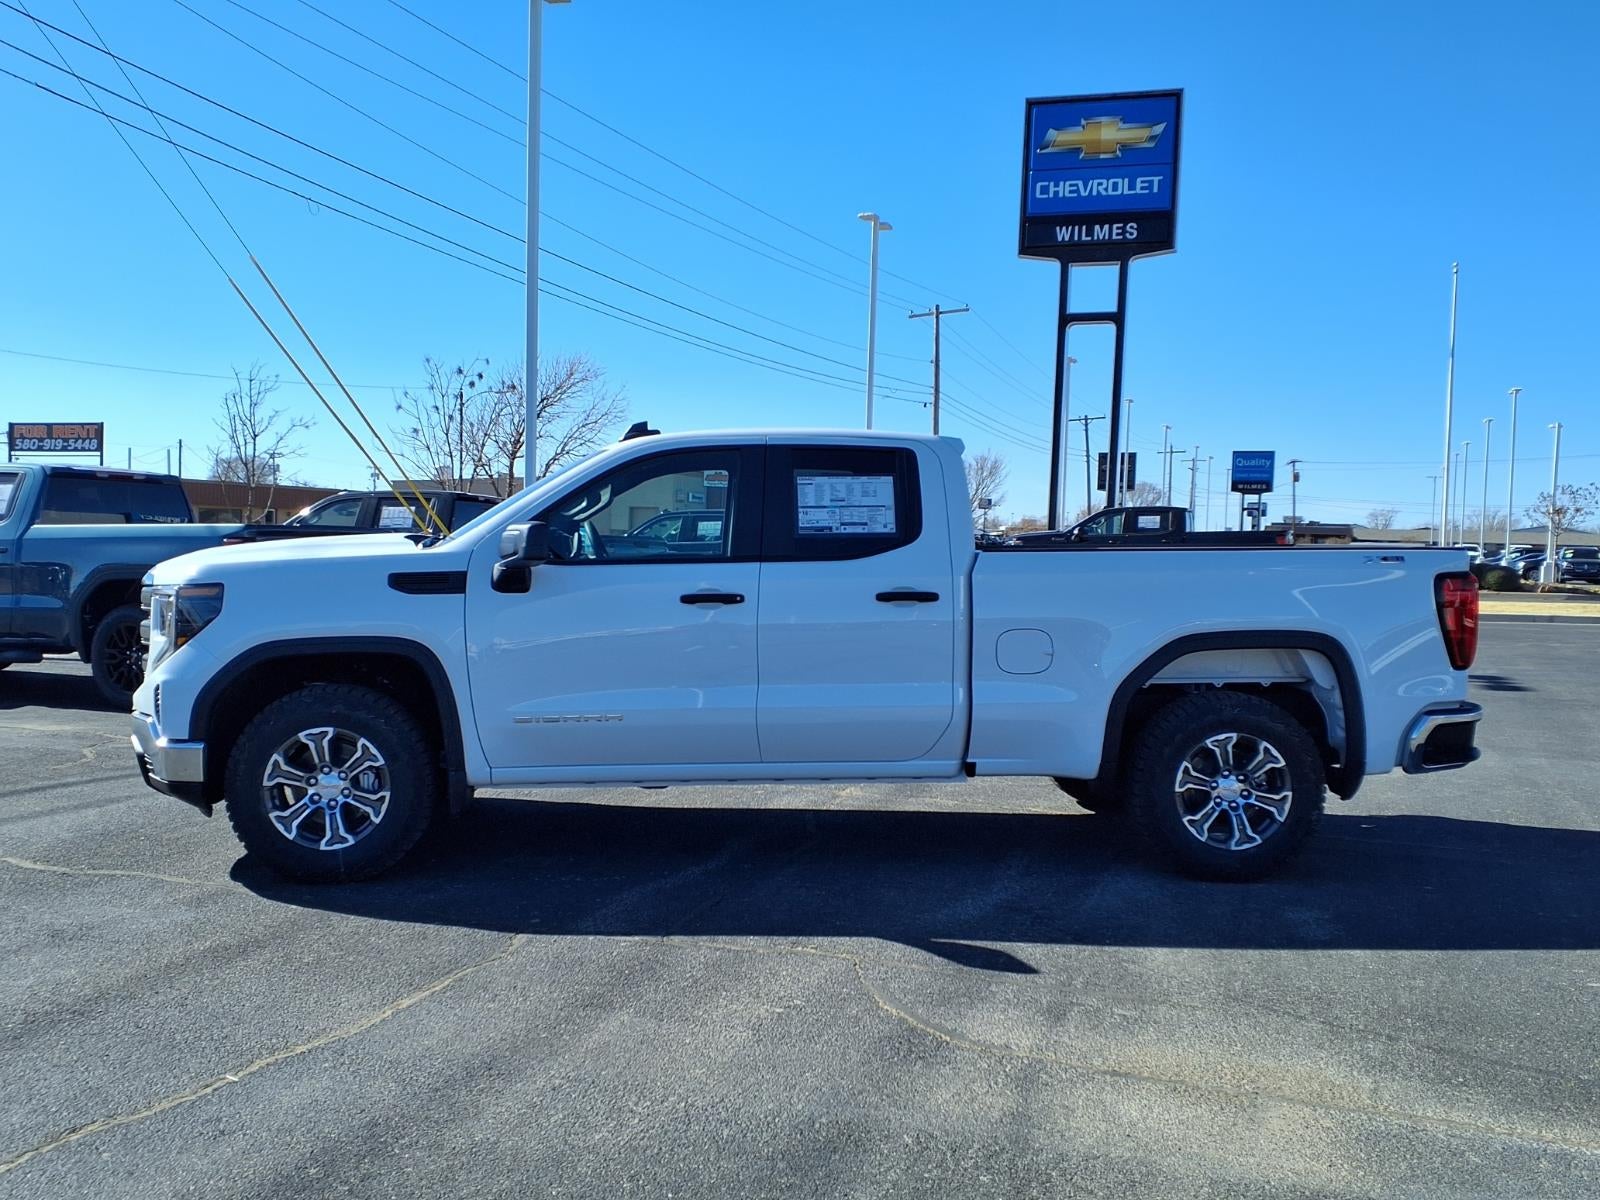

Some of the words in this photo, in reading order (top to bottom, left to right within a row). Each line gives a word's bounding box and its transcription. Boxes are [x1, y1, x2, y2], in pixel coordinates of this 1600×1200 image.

[1035, 176, 1163, 198] CHEVROLET
[1055, 222, 1138, 242] WILMES
[14, 425, 47, 438] FOR
[53, 425, 98, 438] RENT
[1236, 458, 1271, 468] Quality
